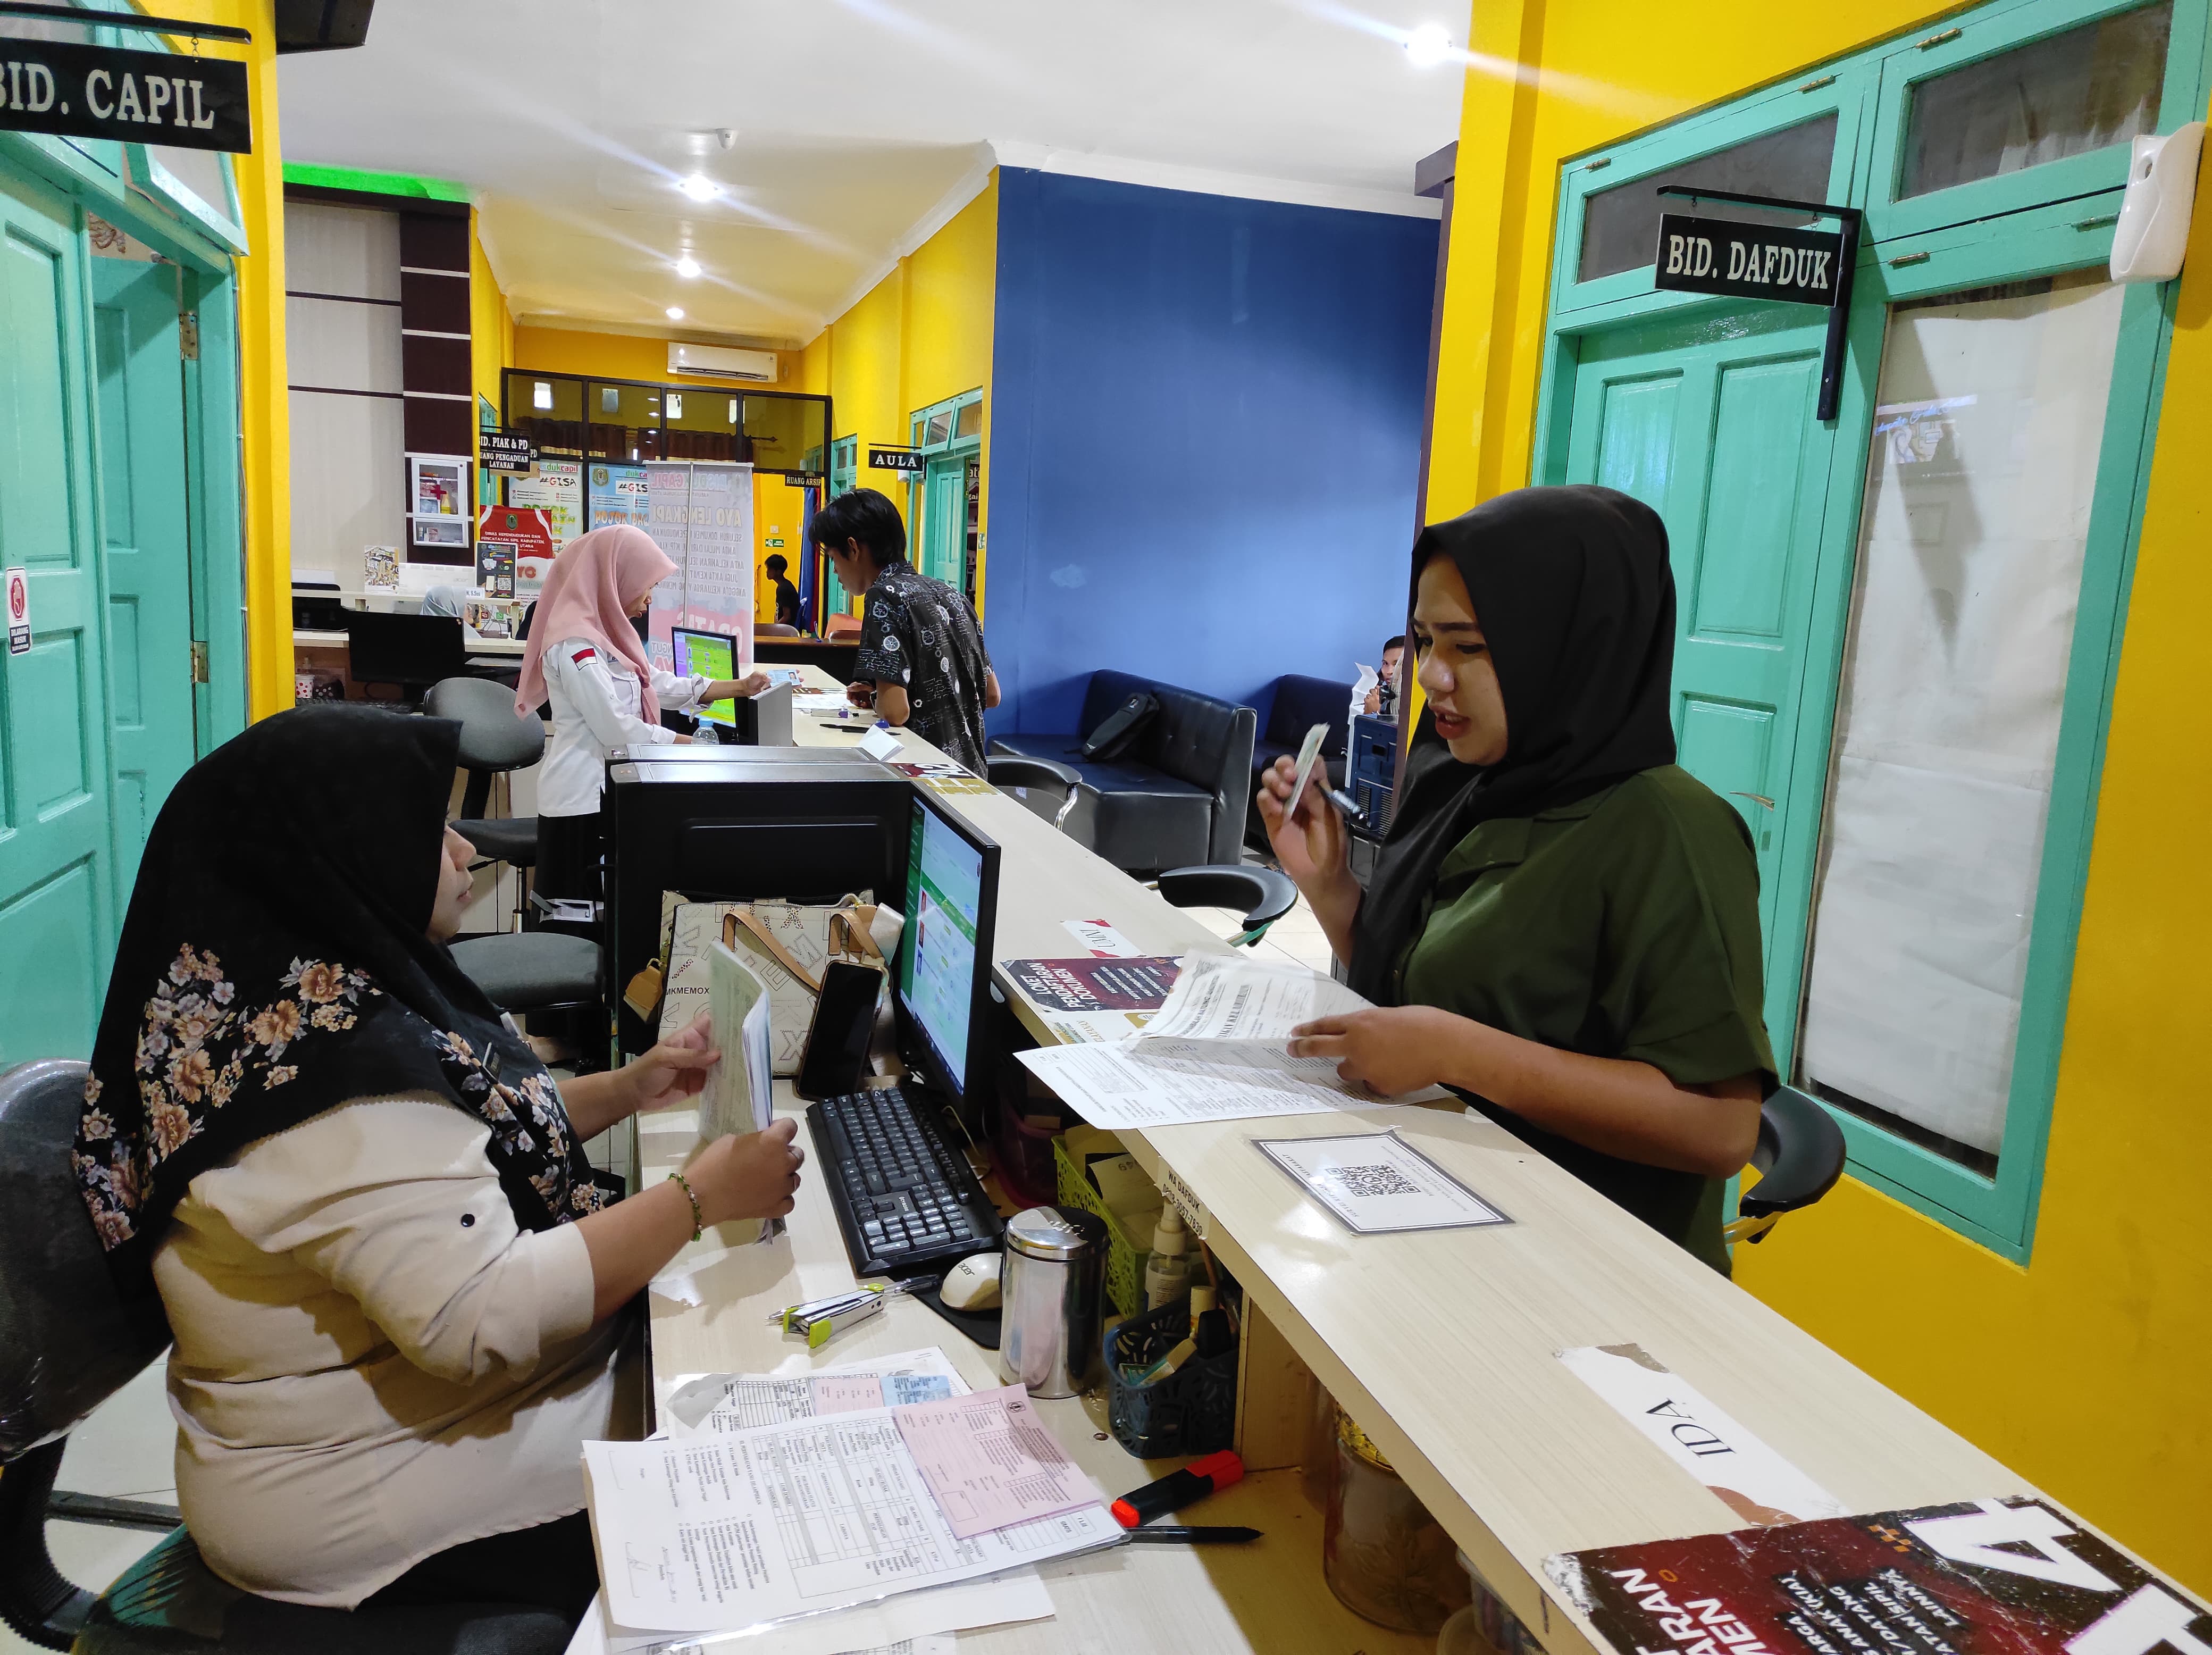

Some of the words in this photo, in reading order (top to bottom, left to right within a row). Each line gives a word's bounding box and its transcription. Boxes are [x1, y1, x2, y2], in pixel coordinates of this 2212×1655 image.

[86, 69, 214, 129] CAPIL
[1666, 235, 1717, 278] BID.
[1727, 241, 1831, 289] DAFDUK
[479, 436, 490, 447] ID.
[493, 437, 509, 448] PIAK
[518, 440, 527, 450] PD
[489, 461, 514, 469] LAYANAN
[496, 453, 528, 462] PENGADUAN
[875, 454, 917, 467] AULA
[618, 483, 648, 492] #GIS
[1019, 974, 1046, 996] LOKET
[1027, 963, 1086, 1008] PENDAFTARAN
[1057, 968, 1091, 1001] DOKUMEN
[1280, 1154, 1315, 1178] ASYARAKAT
[1178, 1181, 1200, 1213] DAFDUK
[958, 1263, 975, 1276] acer
[1646, 1398, 1736, 1458] IDA
[1857, 1581, 1911, 1615] SIPIL
